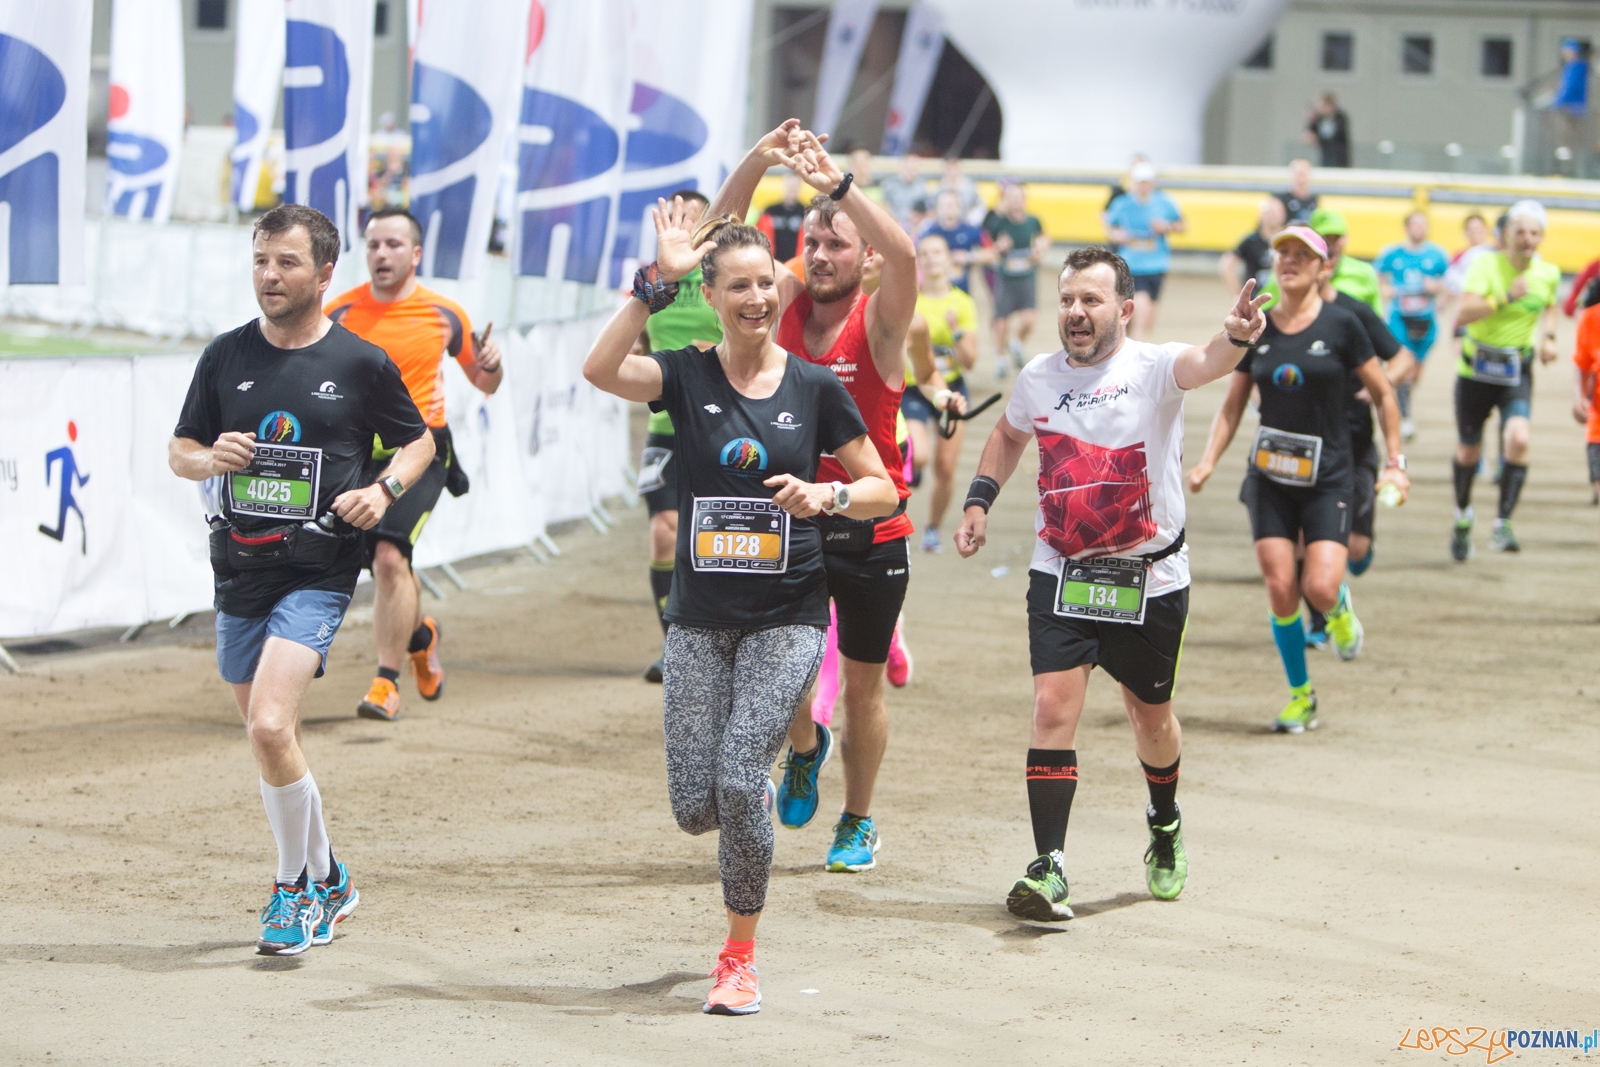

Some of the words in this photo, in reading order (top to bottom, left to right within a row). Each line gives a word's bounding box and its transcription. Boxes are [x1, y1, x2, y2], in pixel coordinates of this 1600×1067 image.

[237, 381, 254, 391] 4F
[247, 479, 291, 502] 4025
[713, 533, 760, 557] 6128
[1088, 586, 1117, 607] 134
